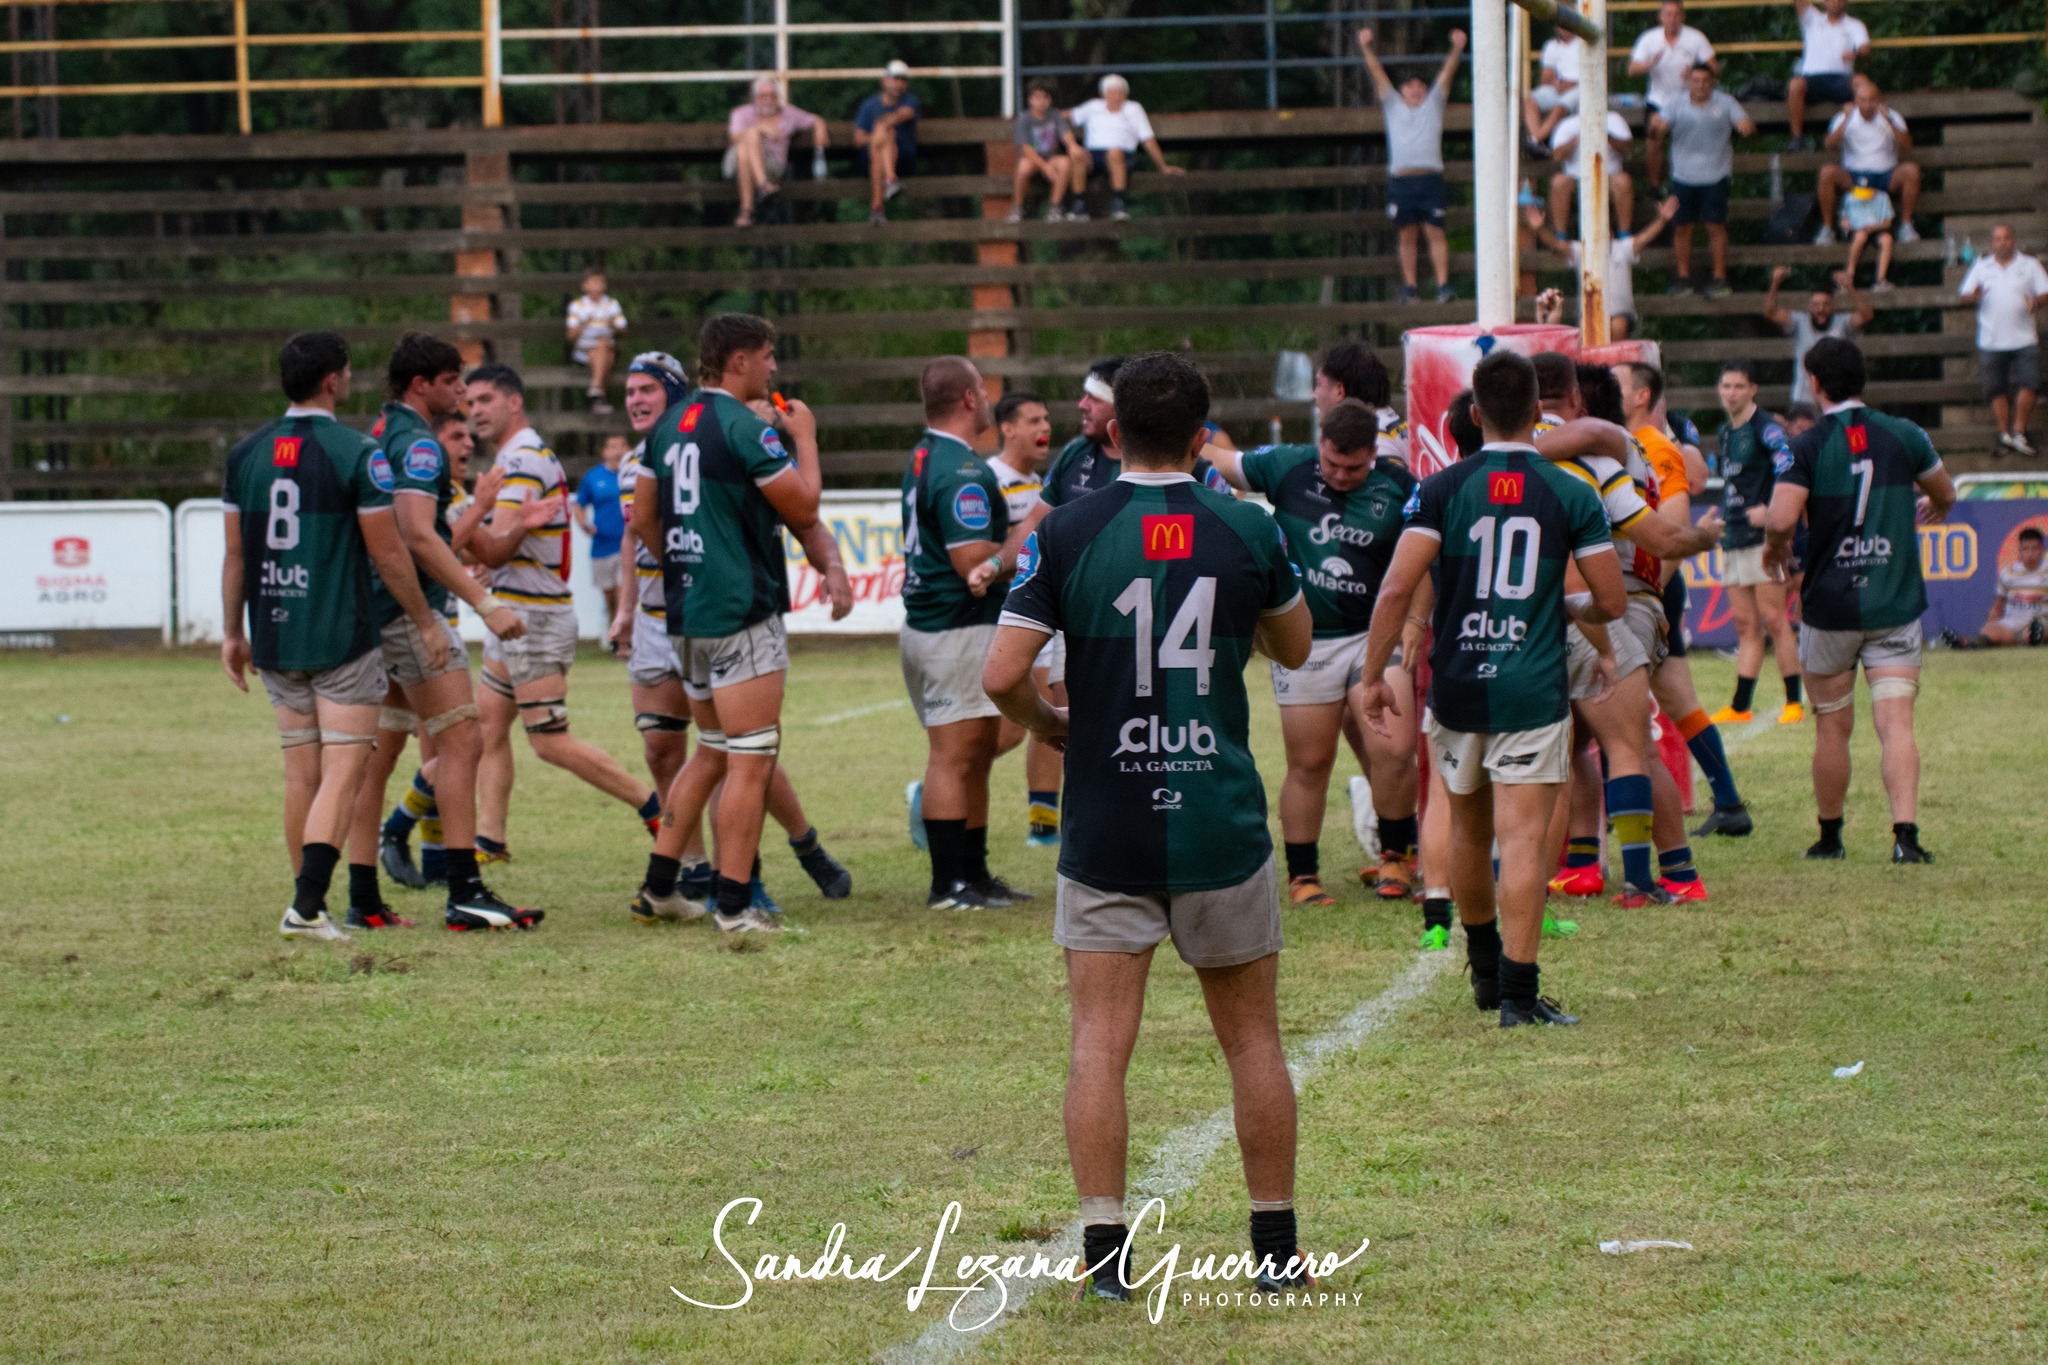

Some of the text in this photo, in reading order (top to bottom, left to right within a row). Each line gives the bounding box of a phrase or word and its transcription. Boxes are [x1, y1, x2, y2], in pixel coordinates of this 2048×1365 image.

[663, 442, 701, 515] 19
[1851, 459, 1874, 527] 7
[266, 478, 300, 550] 8
[1309, 512, 1374, 547] Secco
[1468, 516, 1541, 600] 10
[1834, 534, 1893, 559] Club
[39, 590, 106, 603] AGRO
[1308, 568, 1367, 595] Macro
[1112, 576, 1217, 697] 14
[1456, 610, 1527, 642] Club
[1461, 642, 1521, 651] LA GACETA
[1110, 715, 1220, 758] Club
[1119, 760, 1214, 772] LA GACETA
